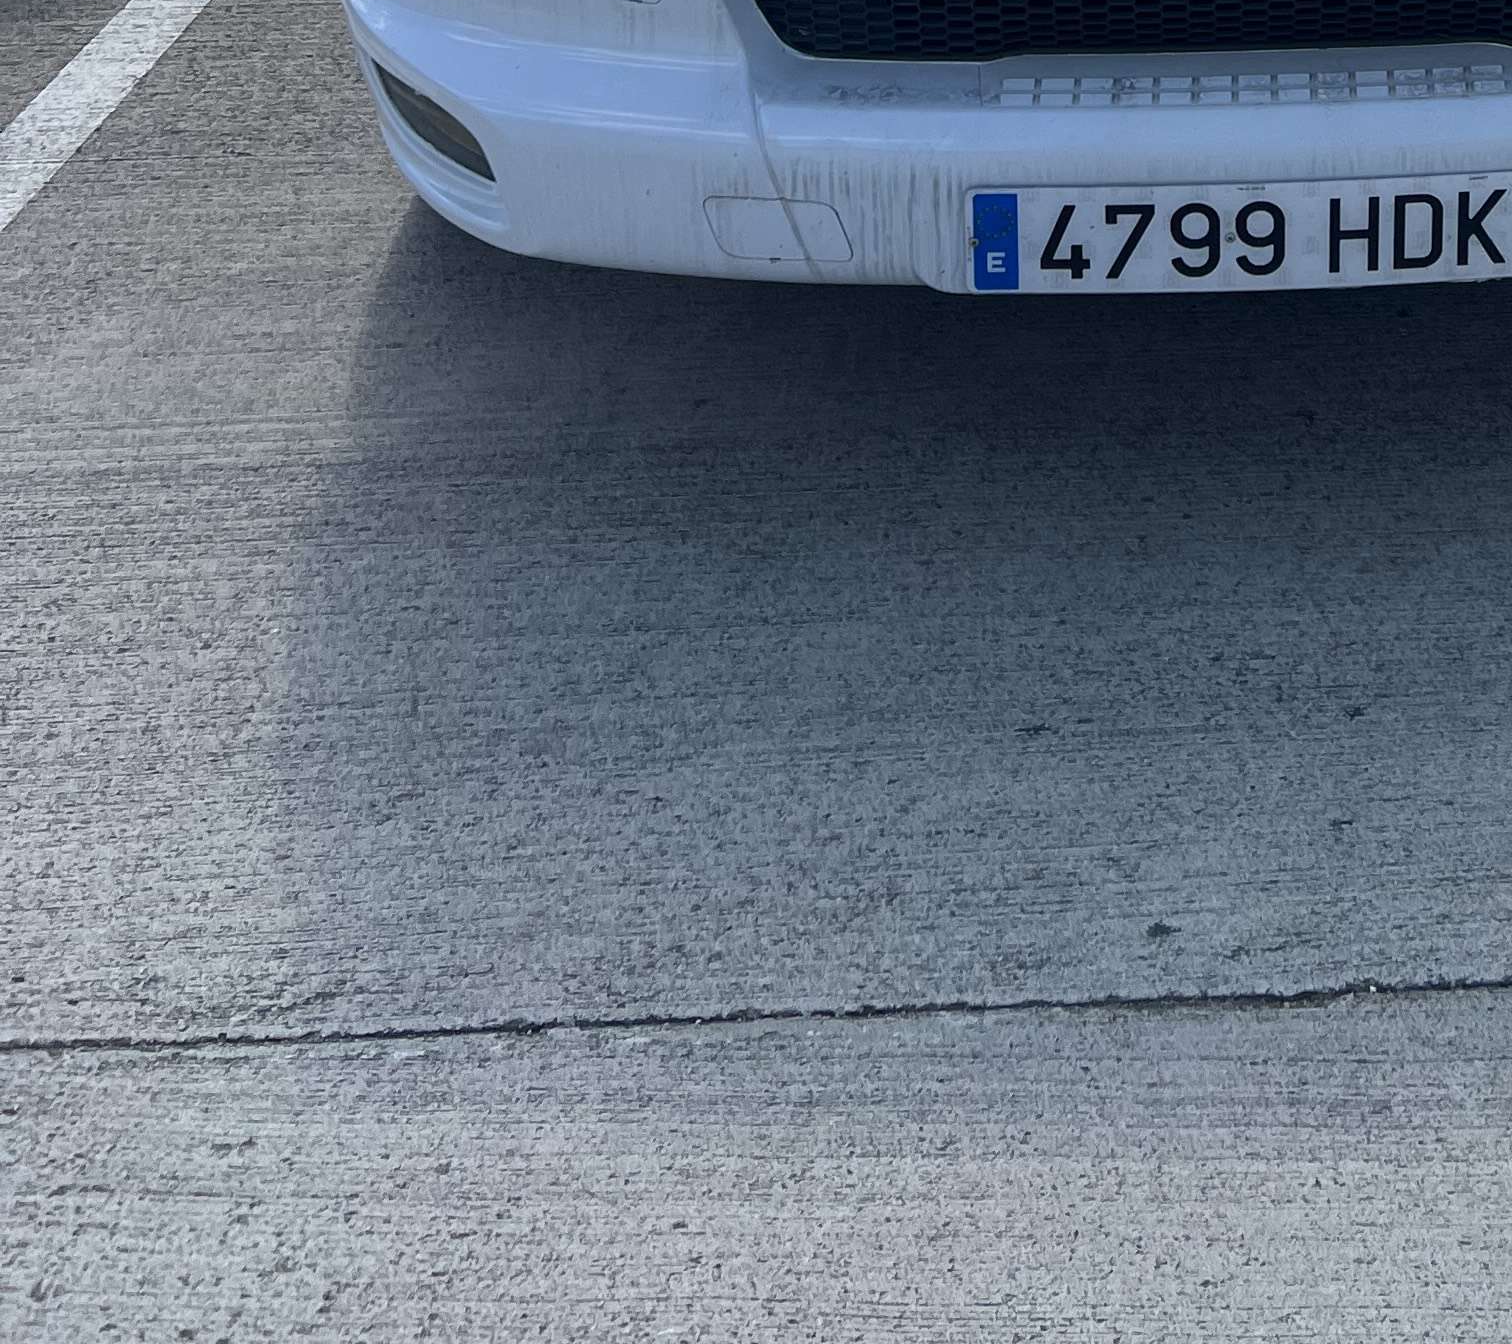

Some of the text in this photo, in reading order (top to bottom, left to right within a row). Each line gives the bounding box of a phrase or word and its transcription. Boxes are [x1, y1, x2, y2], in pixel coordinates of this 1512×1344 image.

[986, 189, 1508, 279] E 4799 HDK
